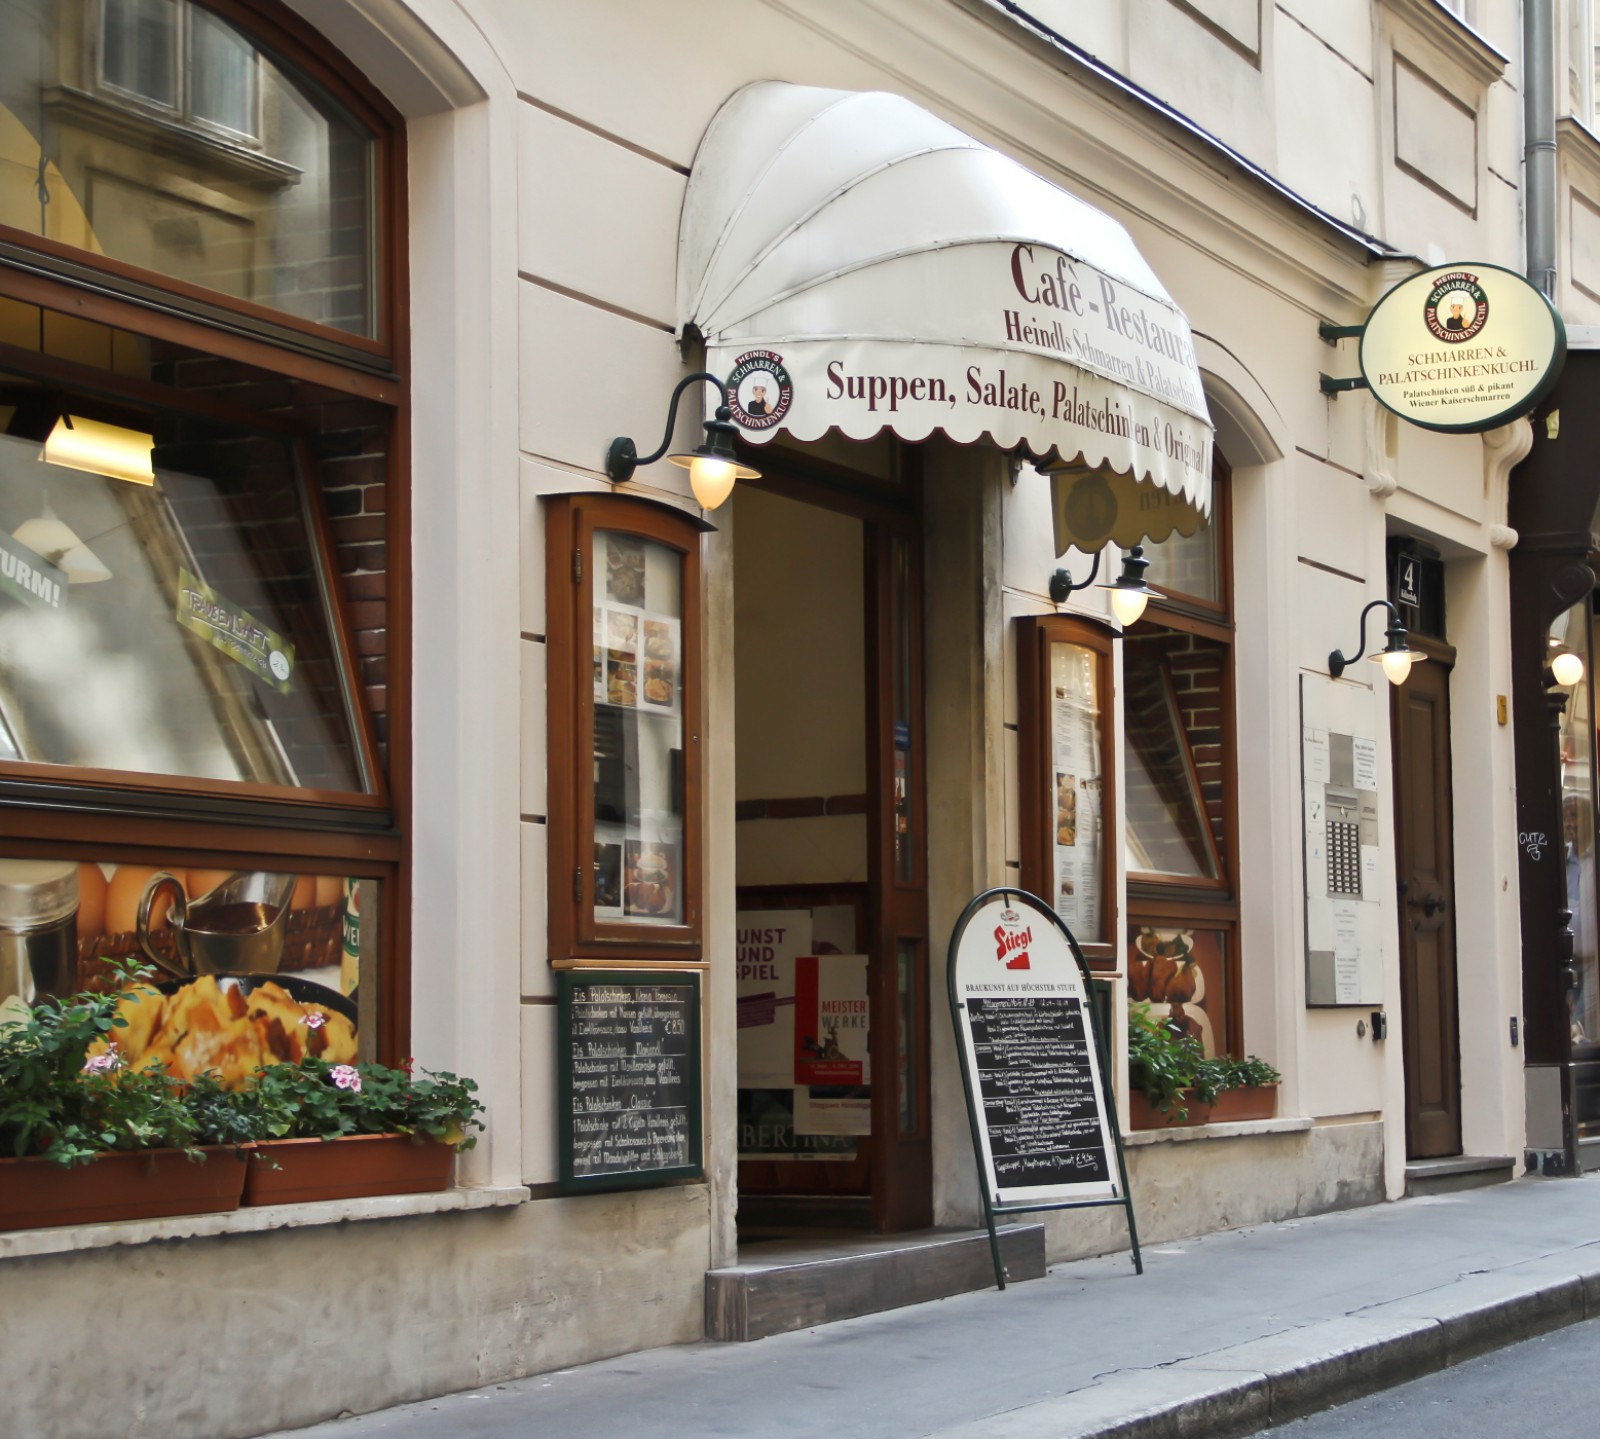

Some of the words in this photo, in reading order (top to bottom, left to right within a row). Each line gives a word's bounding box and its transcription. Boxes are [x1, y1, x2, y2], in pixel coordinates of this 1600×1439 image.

[1436, 273, 1476, 286] HEINDL'S
[1431, 281, 1476, 302] SCHMARREN
[1473, 291, 1481, 299] &
[1427, 302, 1486, 340] PALATSCHINKENKUCHL
[738, 351, 780, 364] HEINDL'S
[1003, 310, 1073, 355] Heindls
[1072, 328, 1139, 381] Schmarren
[1135, 356, 1148, 386] &
[1408, 347, 1493, 366] SCHMARREN
[1496, 346, 1507, 357] &
[732, 360, 781, 384] SCHMARREN
[778, 374, 786, 382] &
[1378, 360, 1538, 385] PALATSCHINKENKUCHL
[1403, 388, 1459, 398] Palatschinken
[1461, 385, 1475, 393] süß
[1487, 382, 1514, 392] pikant
[1441, 393, 1510, 405] Kaiserschmarren
[727, 387, 791, 428] PALATSCHINKENKUCHL
[827, 360, 956, 412] Suppen,
[966, 365, 1045, 423] Salate,
[1152, 417, 1163, 453] &
[1164, 422, 1205, 476] Original
[0, 547, 60, 608] URM!
[1404, 562, 1413, 590] 4
[737, 929, 786, 944] UNST
[993, 925, 1032, 961] Stiegl
[736, 947, 775, 962] UND
[1021, 982, 1055, 991] HÖCHSTER
[822, 1000, 866, 1013] MEISTER
[822, 1015, 866, 1029] WERKE
